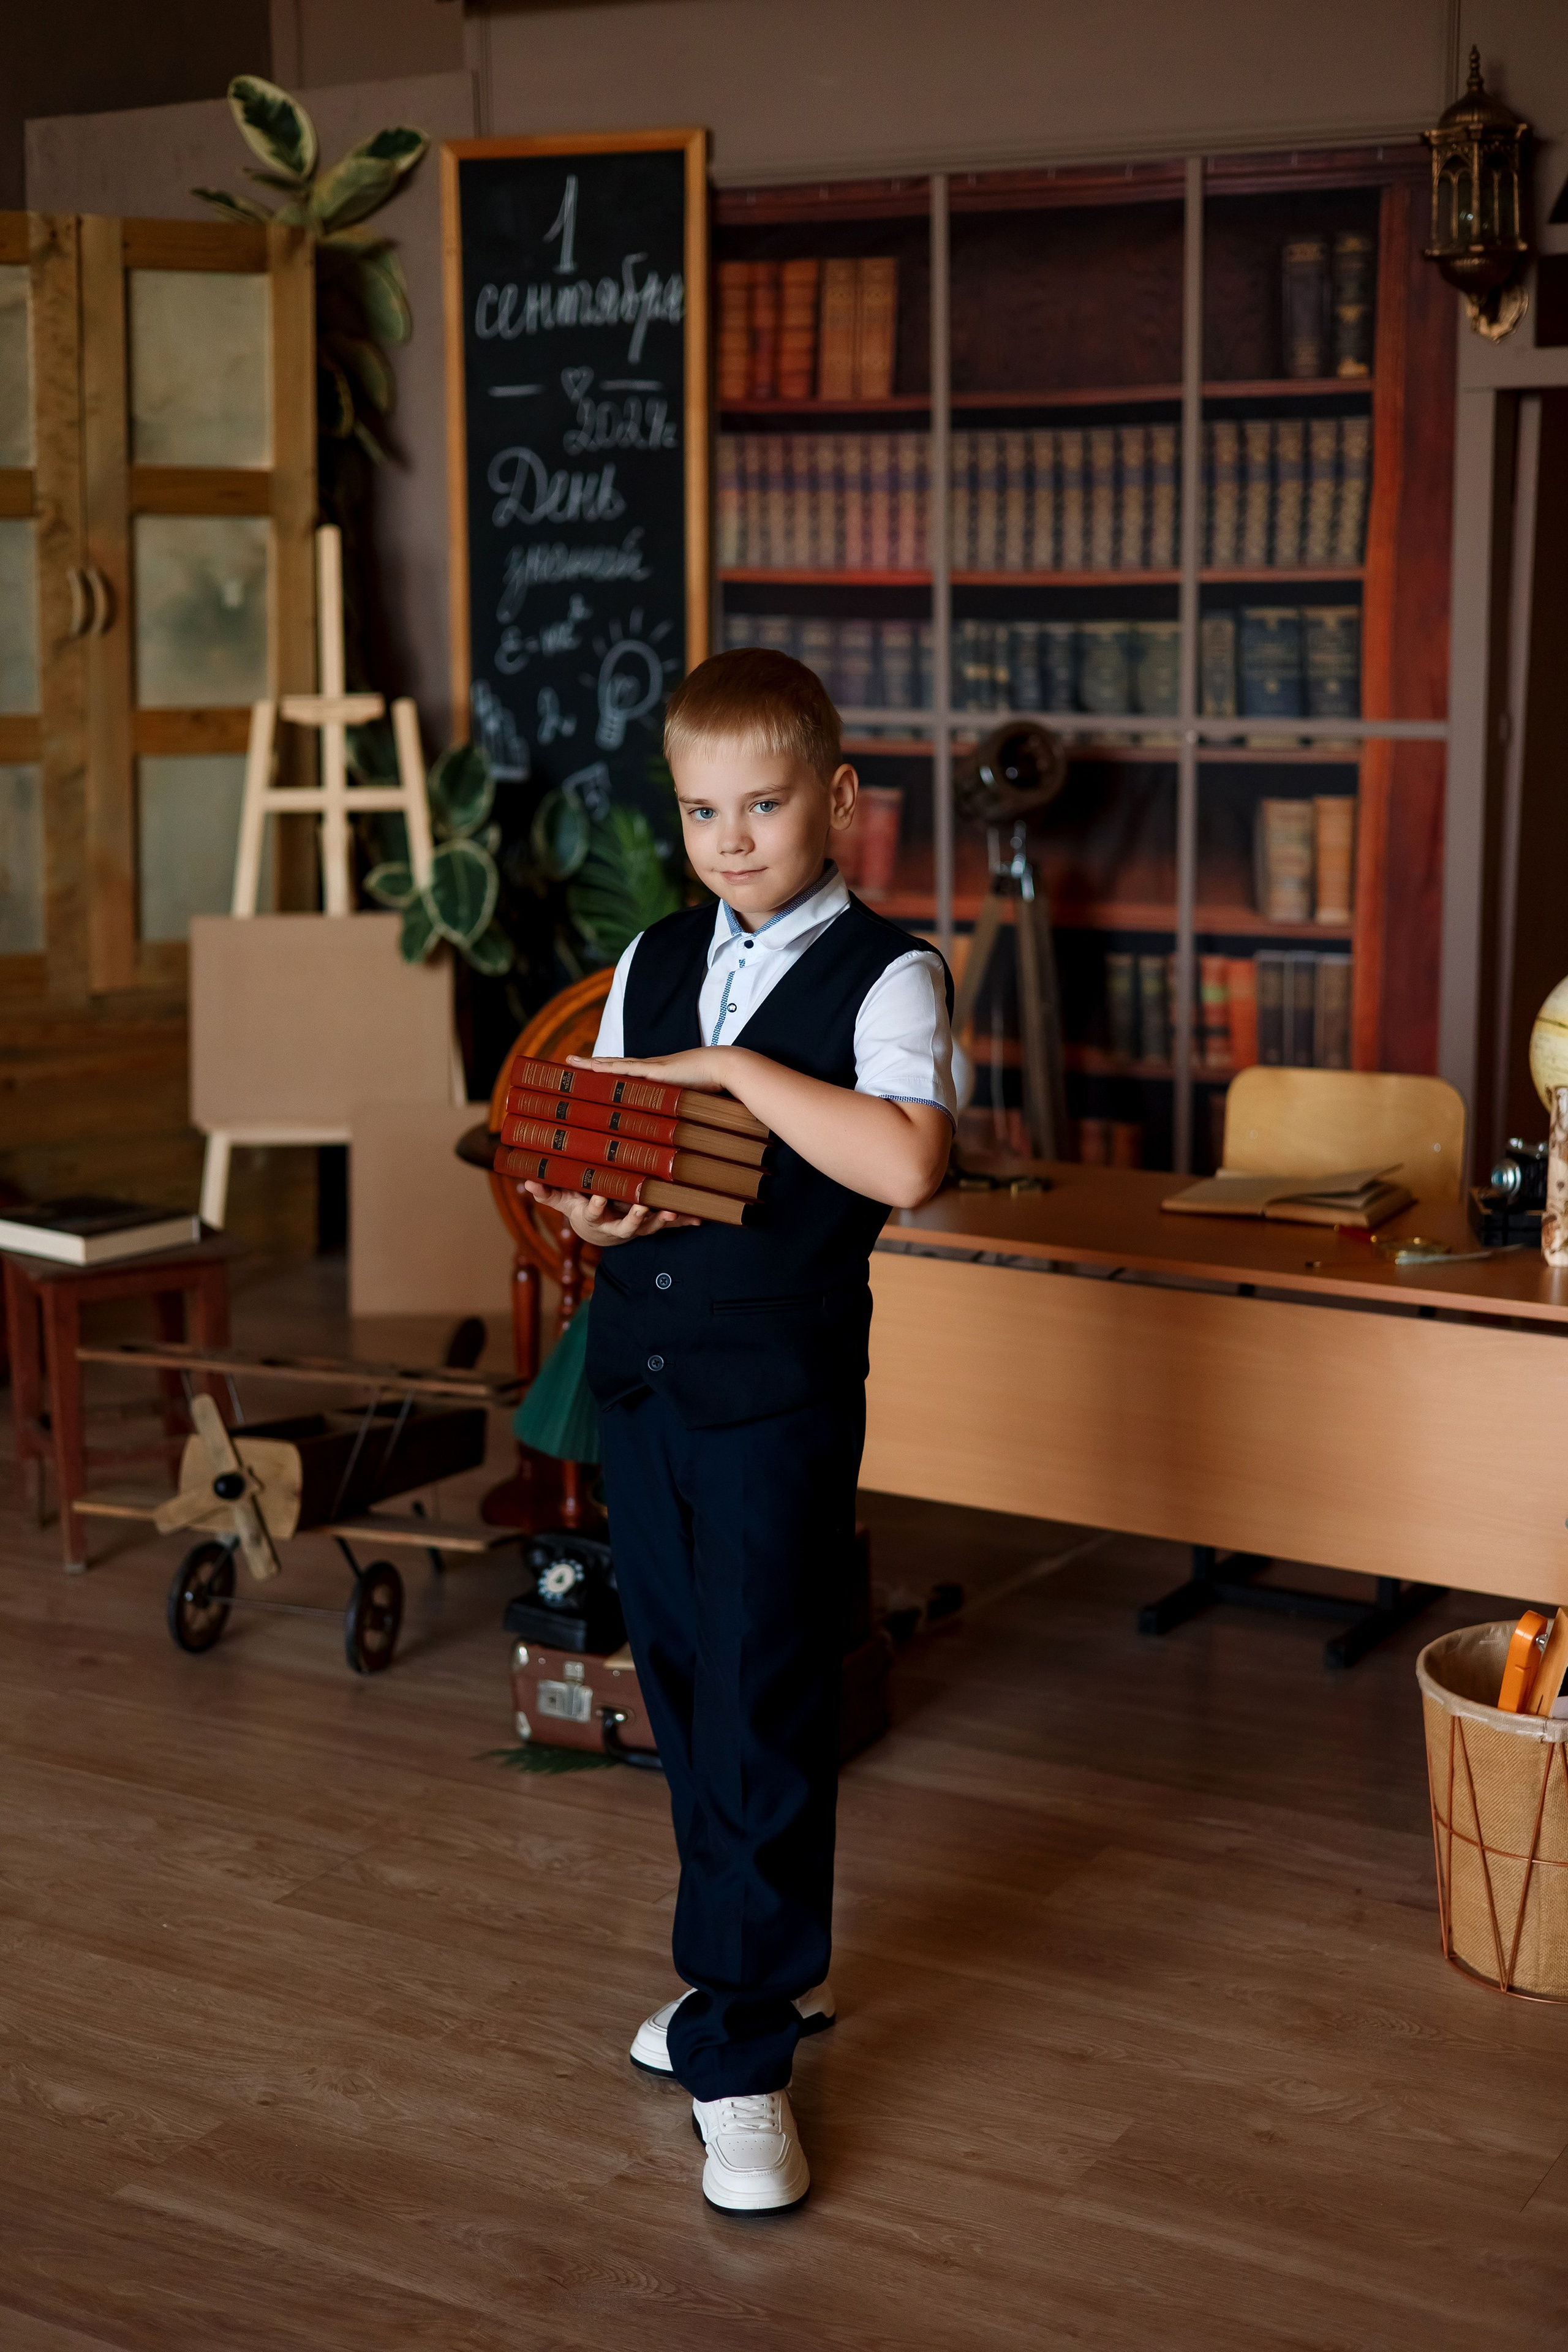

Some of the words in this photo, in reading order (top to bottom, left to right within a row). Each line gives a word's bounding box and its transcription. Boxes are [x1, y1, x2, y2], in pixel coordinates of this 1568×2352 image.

[544, 174, 578, 273] 1
[475, 252, 684, 363] сентября
[488, 446, 626, 528] День
